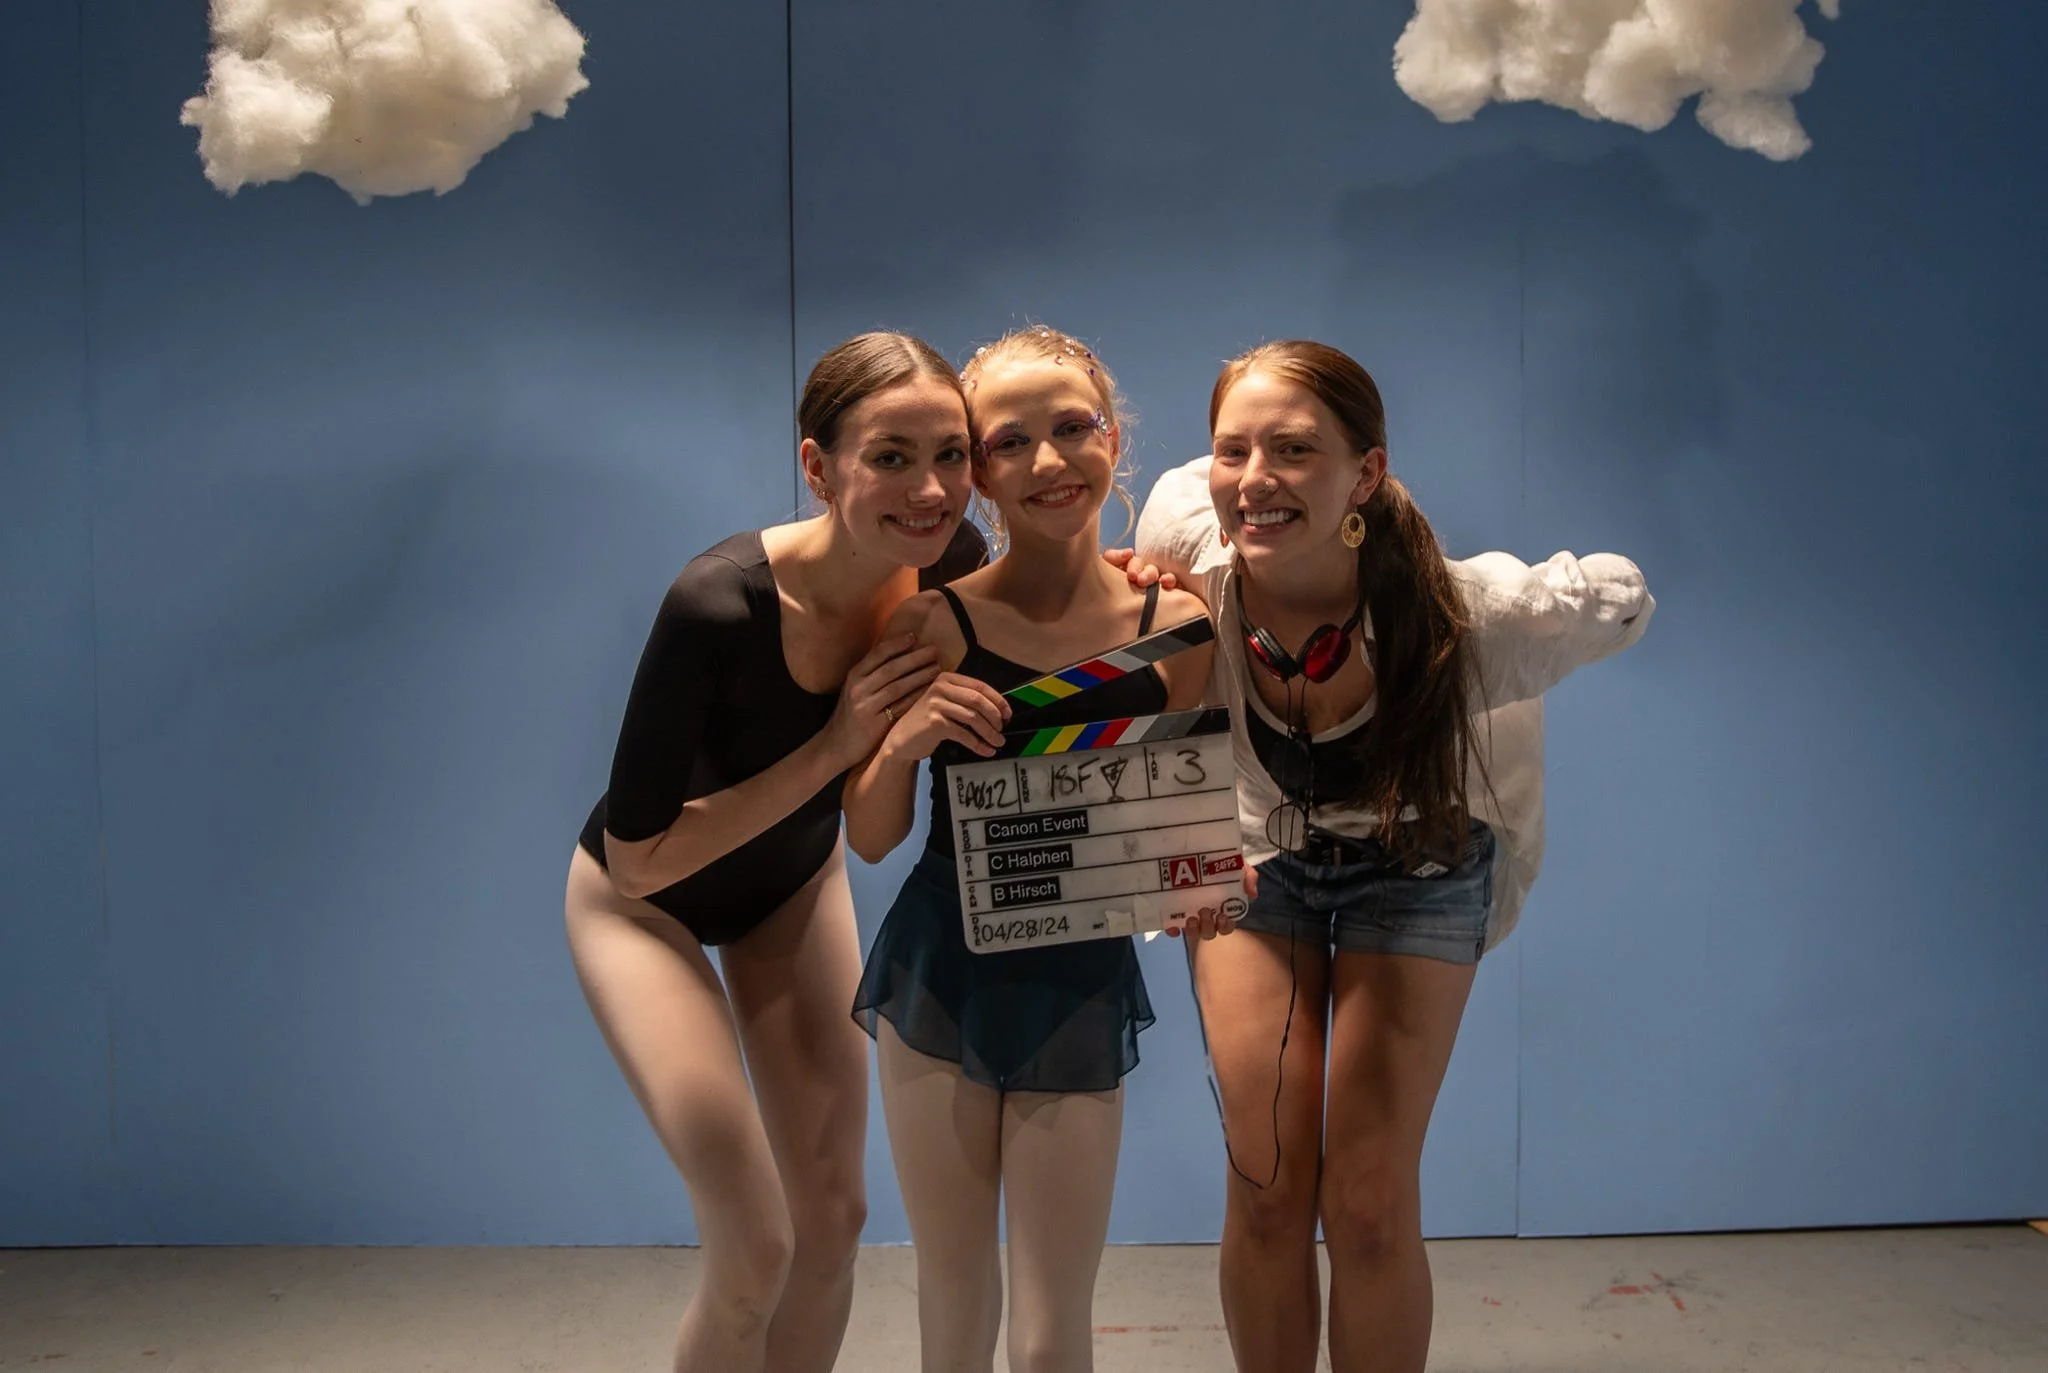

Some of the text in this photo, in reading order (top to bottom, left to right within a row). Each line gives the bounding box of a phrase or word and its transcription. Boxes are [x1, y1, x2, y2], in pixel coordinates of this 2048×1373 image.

[1150, 752, 1158, 780] TAKE
[1174, 750, 1206, 785] 3
[961, 822, 971, 850] PROD
[989, 815, 1086, 838] Canon Event
[965, 856, 973, 877] DIR
[991, 850, 1070, 870] C Halphen
[1162, 860, 1170, 882] CAM
[1214, 858, 1237, 872] 24FPS
[1174, 861, 1196, 885] A
[968, 886, 977, 908] CAM
[994, 882, 1057, 901] B Hirsch
[972, 917, 982, 946] DATE
[982, 916, 1070, 943] 04/28/24
